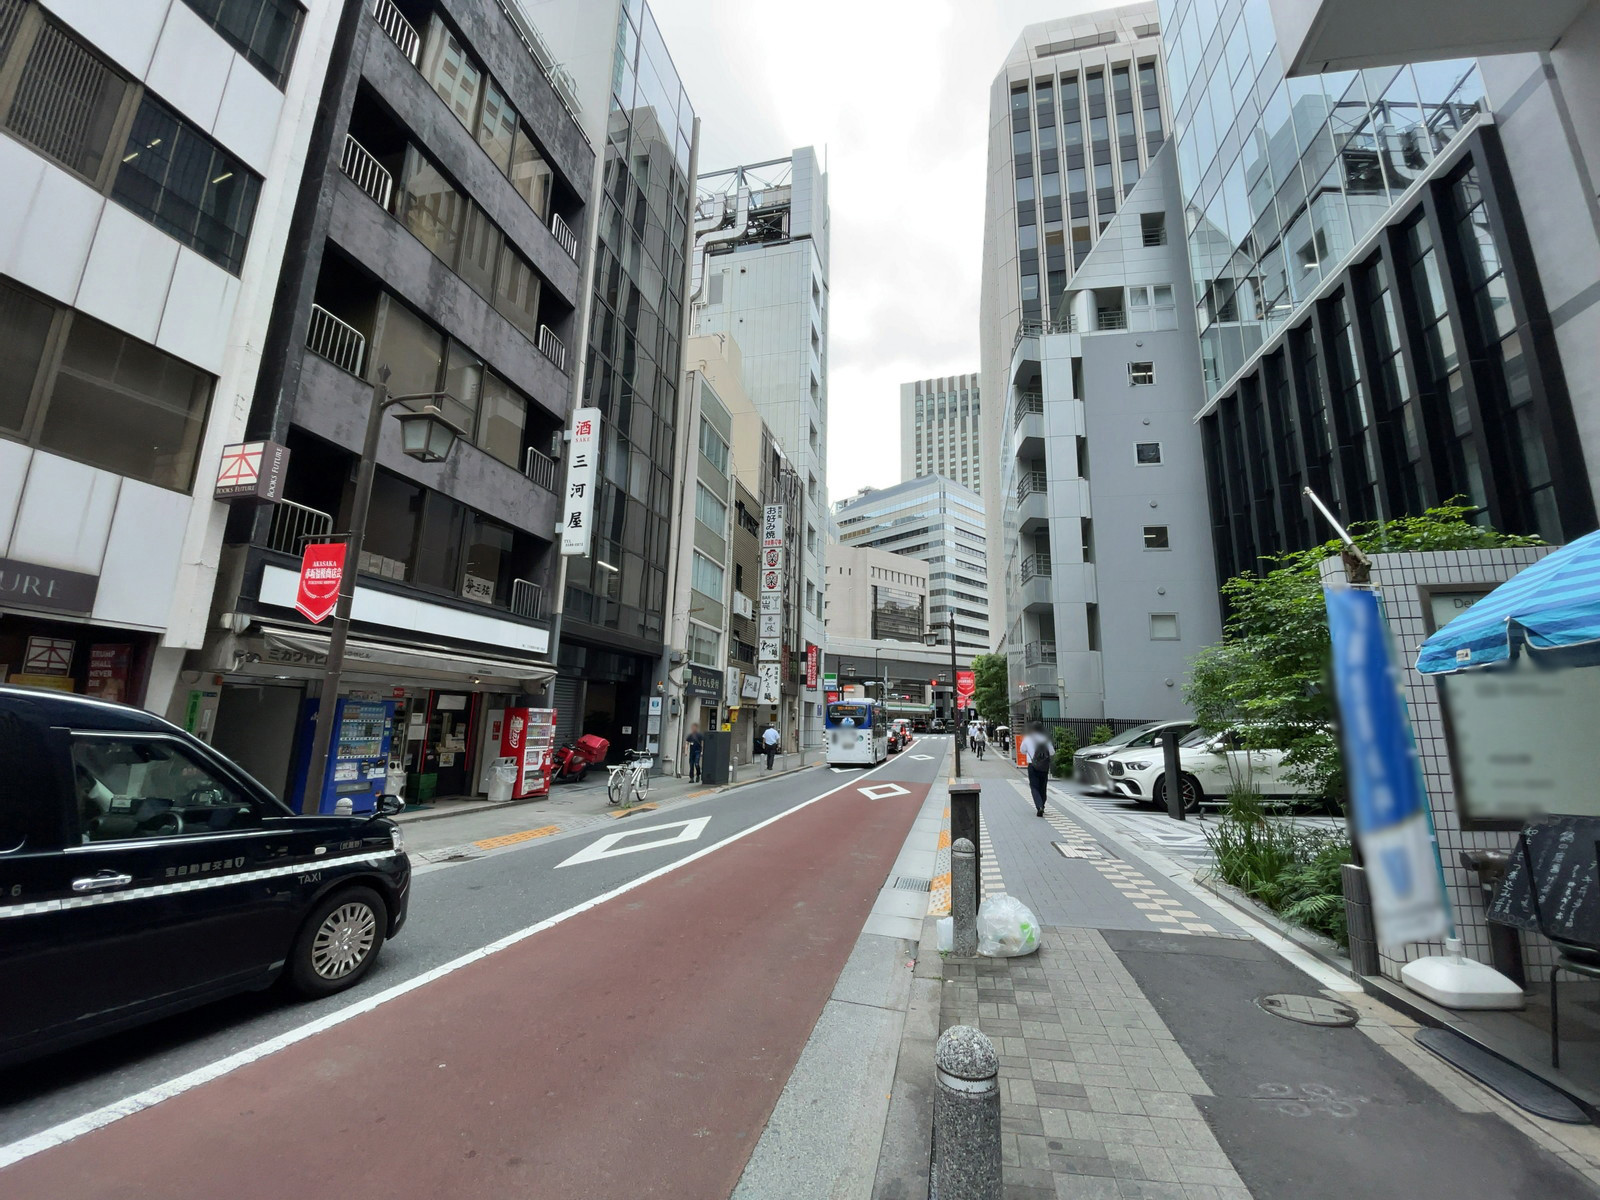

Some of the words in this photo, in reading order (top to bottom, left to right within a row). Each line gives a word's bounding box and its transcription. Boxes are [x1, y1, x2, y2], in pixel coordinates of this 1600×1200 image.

[575, 420, 592, 436] 酒
[271, 448, 283, 474] FUTURE
[216, 487, 234, 495] BOOKS
[234, 485, 256, 493] FUTURE
[266, 475, 278, 498] BOOKS
[567, 454, 588, 529] 三河屋
[765, 507, 777, 539] お好み焼
[92, 650, 116, 658] TRUMP
[269, 648, 328, 666] ミカワヤビ
[91, 660, 111, 668] SHALL
[89, 670, 112, 678] NEVER
[88, 679, 101, 687] DIE
[165, 858, 233, 878] 宝自動車交通
[298, 872, 322, 885] TAXI
